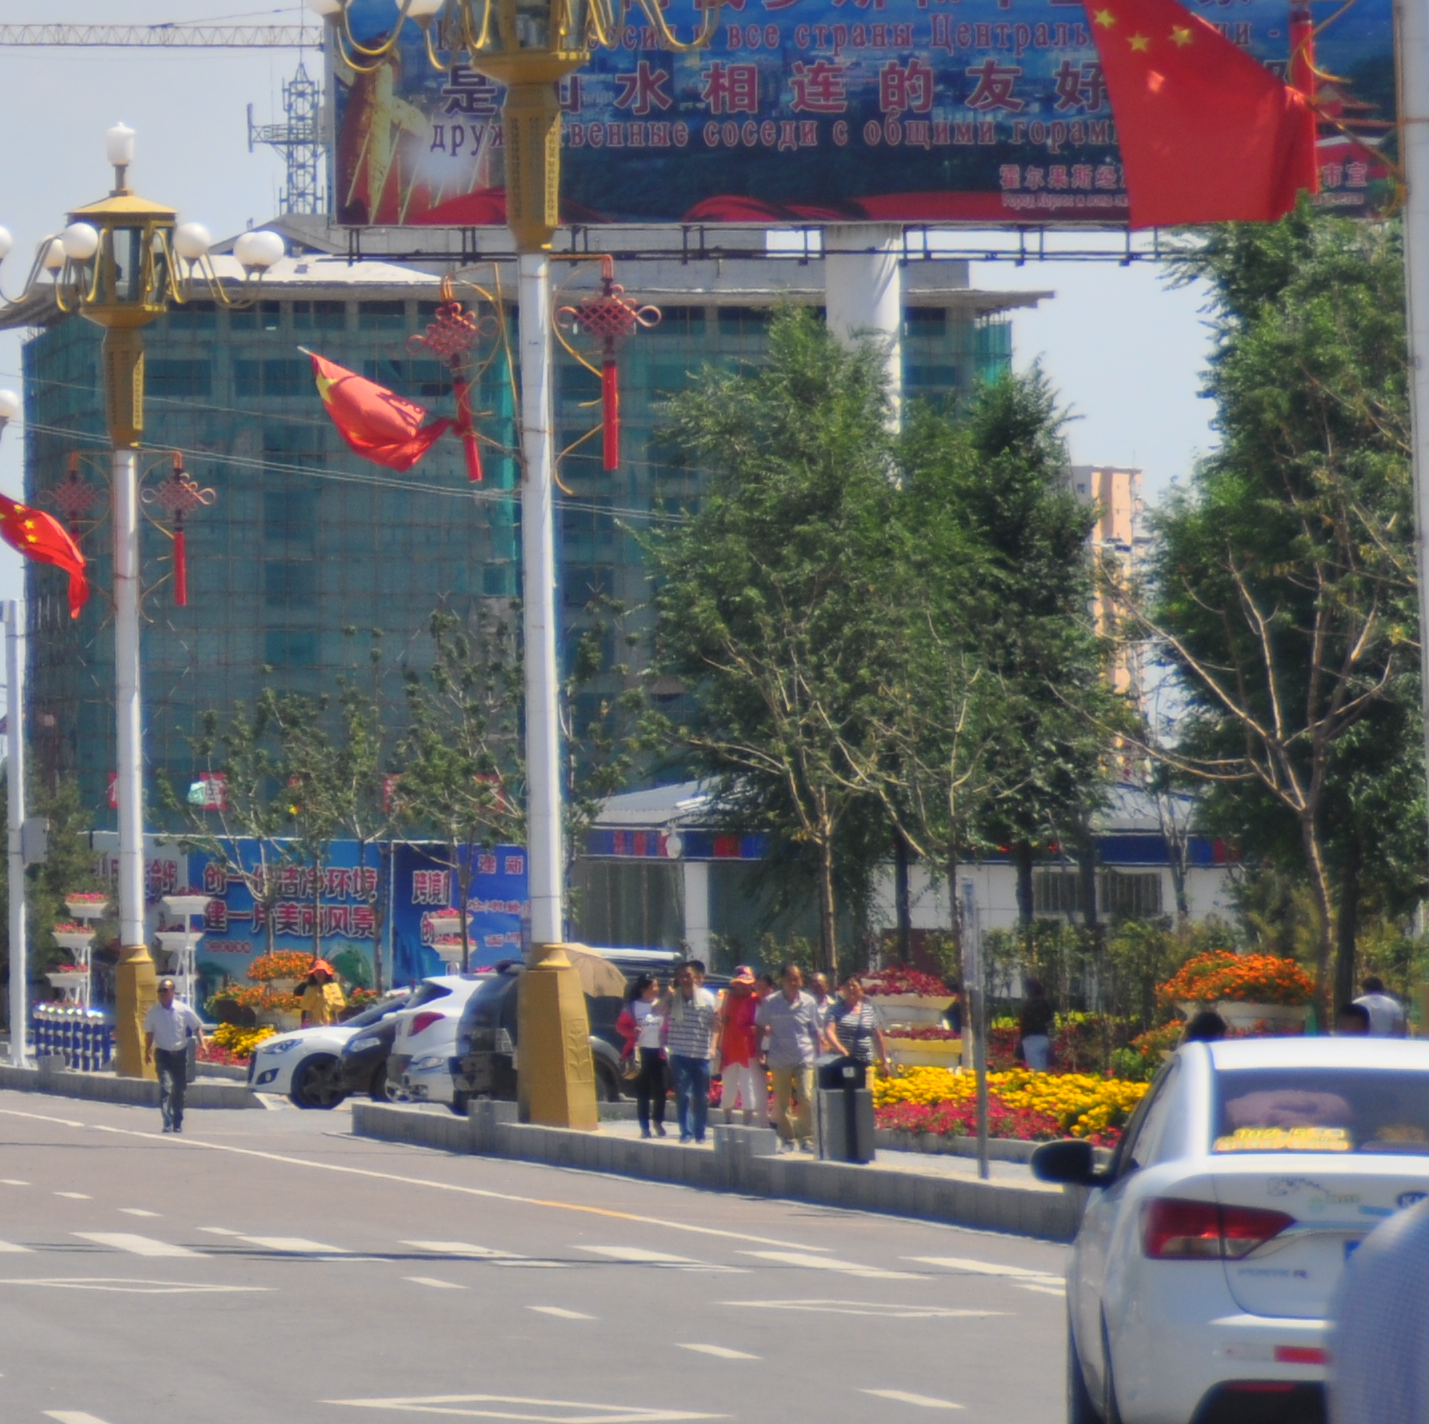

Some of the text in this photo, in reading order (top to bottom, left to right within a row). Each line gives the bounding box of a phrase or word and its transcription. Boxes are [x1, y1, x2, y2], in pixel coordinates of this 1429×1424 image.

[726, 23, 780, 51] все
[794, 21, 921, 55] страны
[929, 13, 1090, 57] Централь
[703, 120, 818, 151] соседи
[833, 121, 849, 147] с
[862, 108, 996, 148] общими
